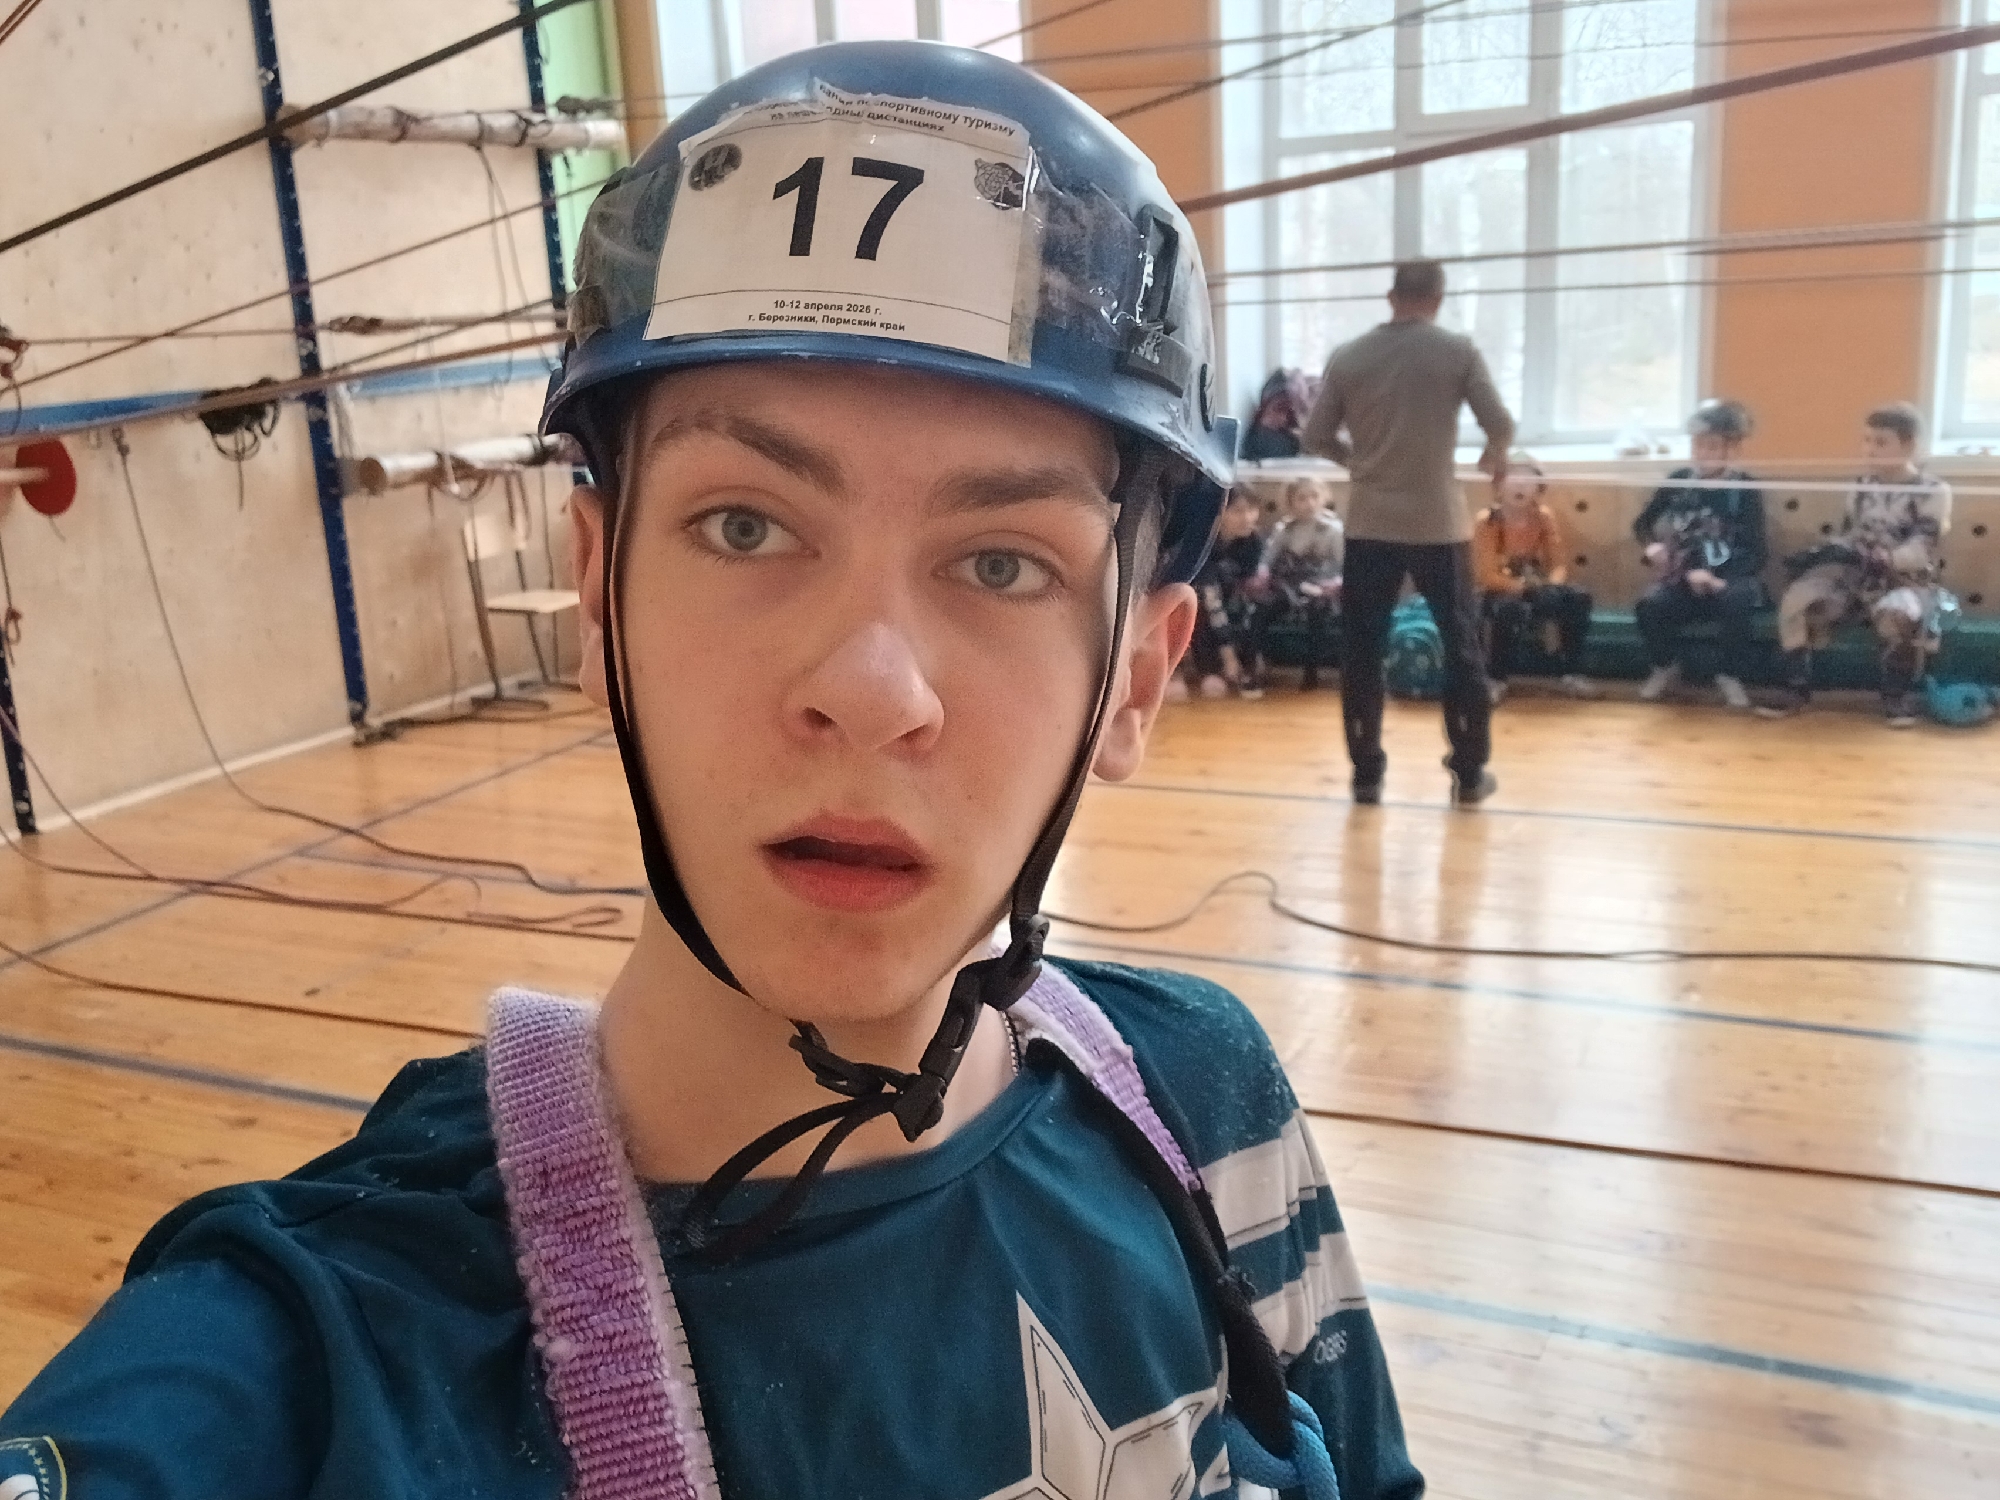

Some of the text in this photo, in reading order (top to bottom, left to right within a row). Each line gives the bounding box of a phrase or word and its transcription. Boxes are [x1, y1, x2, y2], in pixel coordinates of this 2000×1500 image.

[866, 111, 945, 132] дистанциях
[963, 115, 1016, 137] туризму
[772, 156, 926, 261] 17
[773, 299, 882, 316] 10-12 апреля 2026 г.
[748, 312, 906, 332] г. Березники, Пермский край
